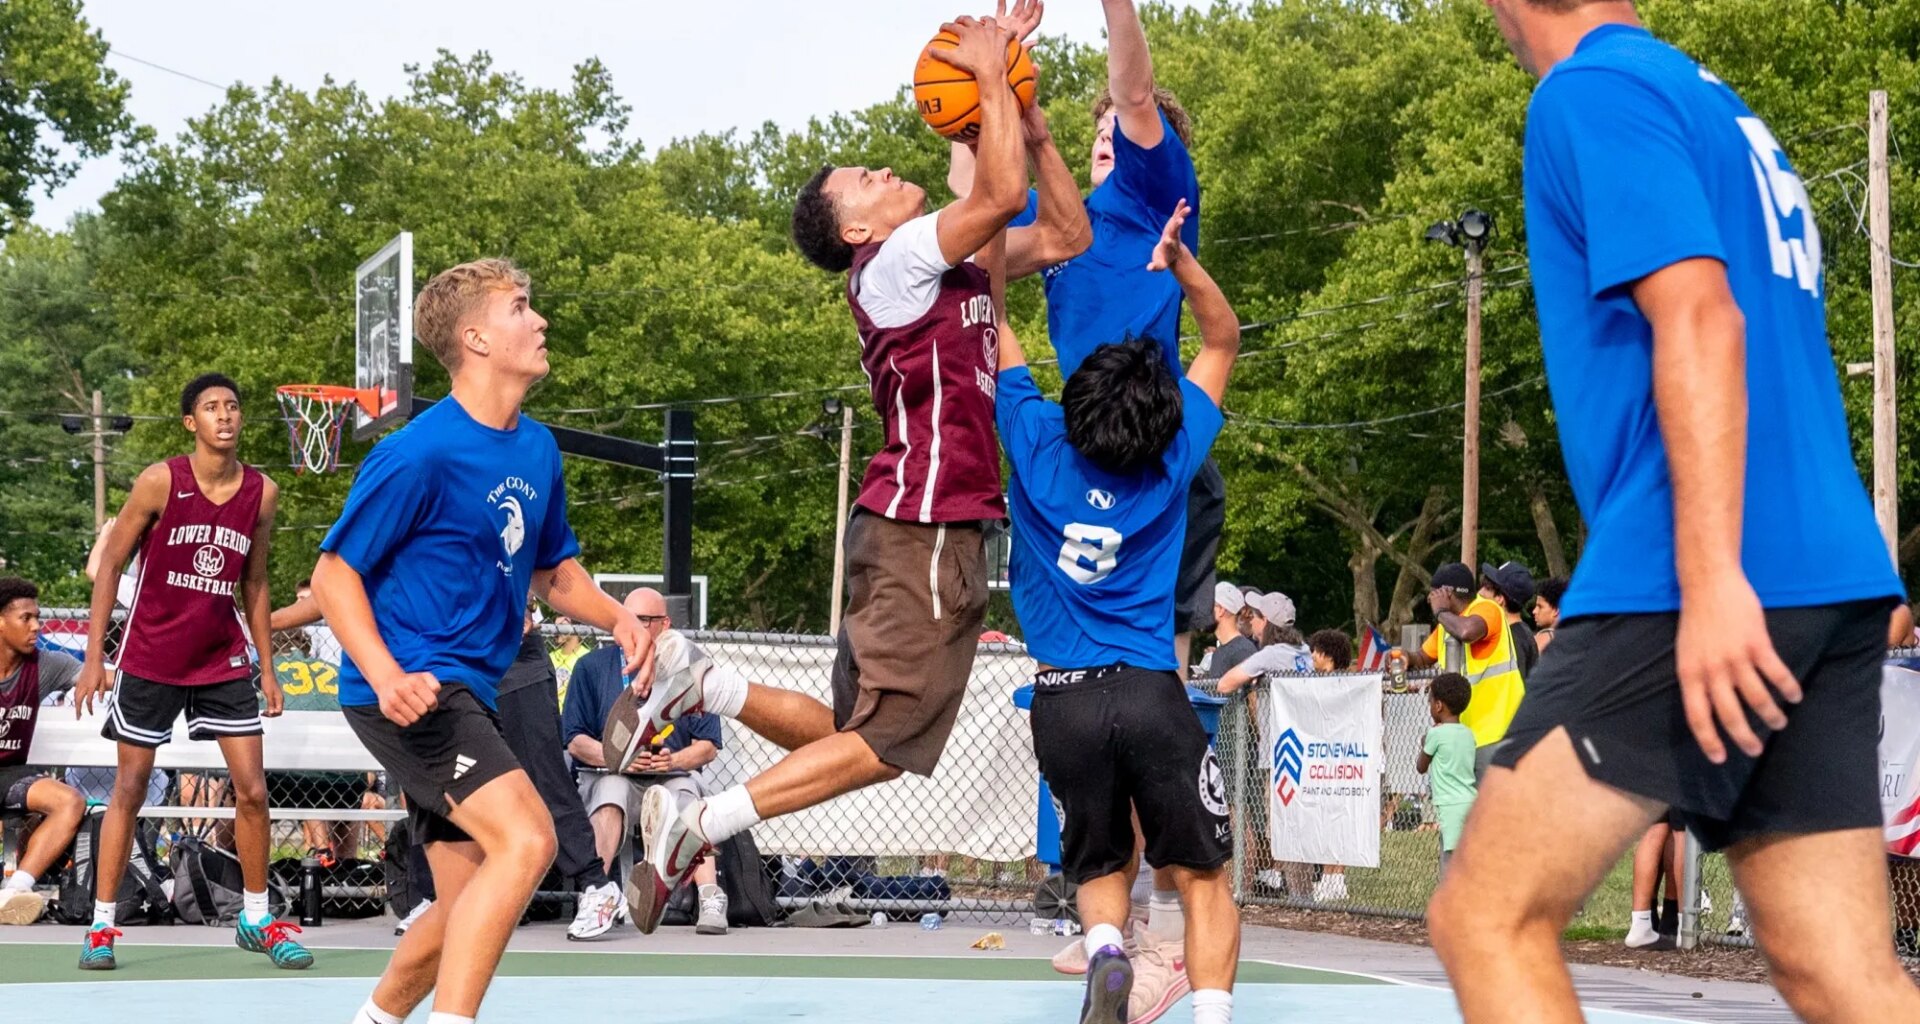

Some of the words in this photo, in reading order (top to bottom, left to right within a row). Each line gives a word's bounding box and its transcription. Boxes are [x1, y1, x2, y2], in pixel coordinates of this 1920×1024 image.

[505, 476, 538, 501] GOAT
[166, 524, 212, 546] LOWER
[213, 525, 252, 557] MERION
[1057, 522, 1122, 585] 8
[166, 570, 233, 596] BASKETBAL
[277, 660, 339, 696] 32
[1038, 670, 1087, 687] NIKE
[1307, 742, 1369, 758] STONEWALL
[1309, 764, 1363, 780] COLLISION
[1334, 787, 1351, 797] AUTO
